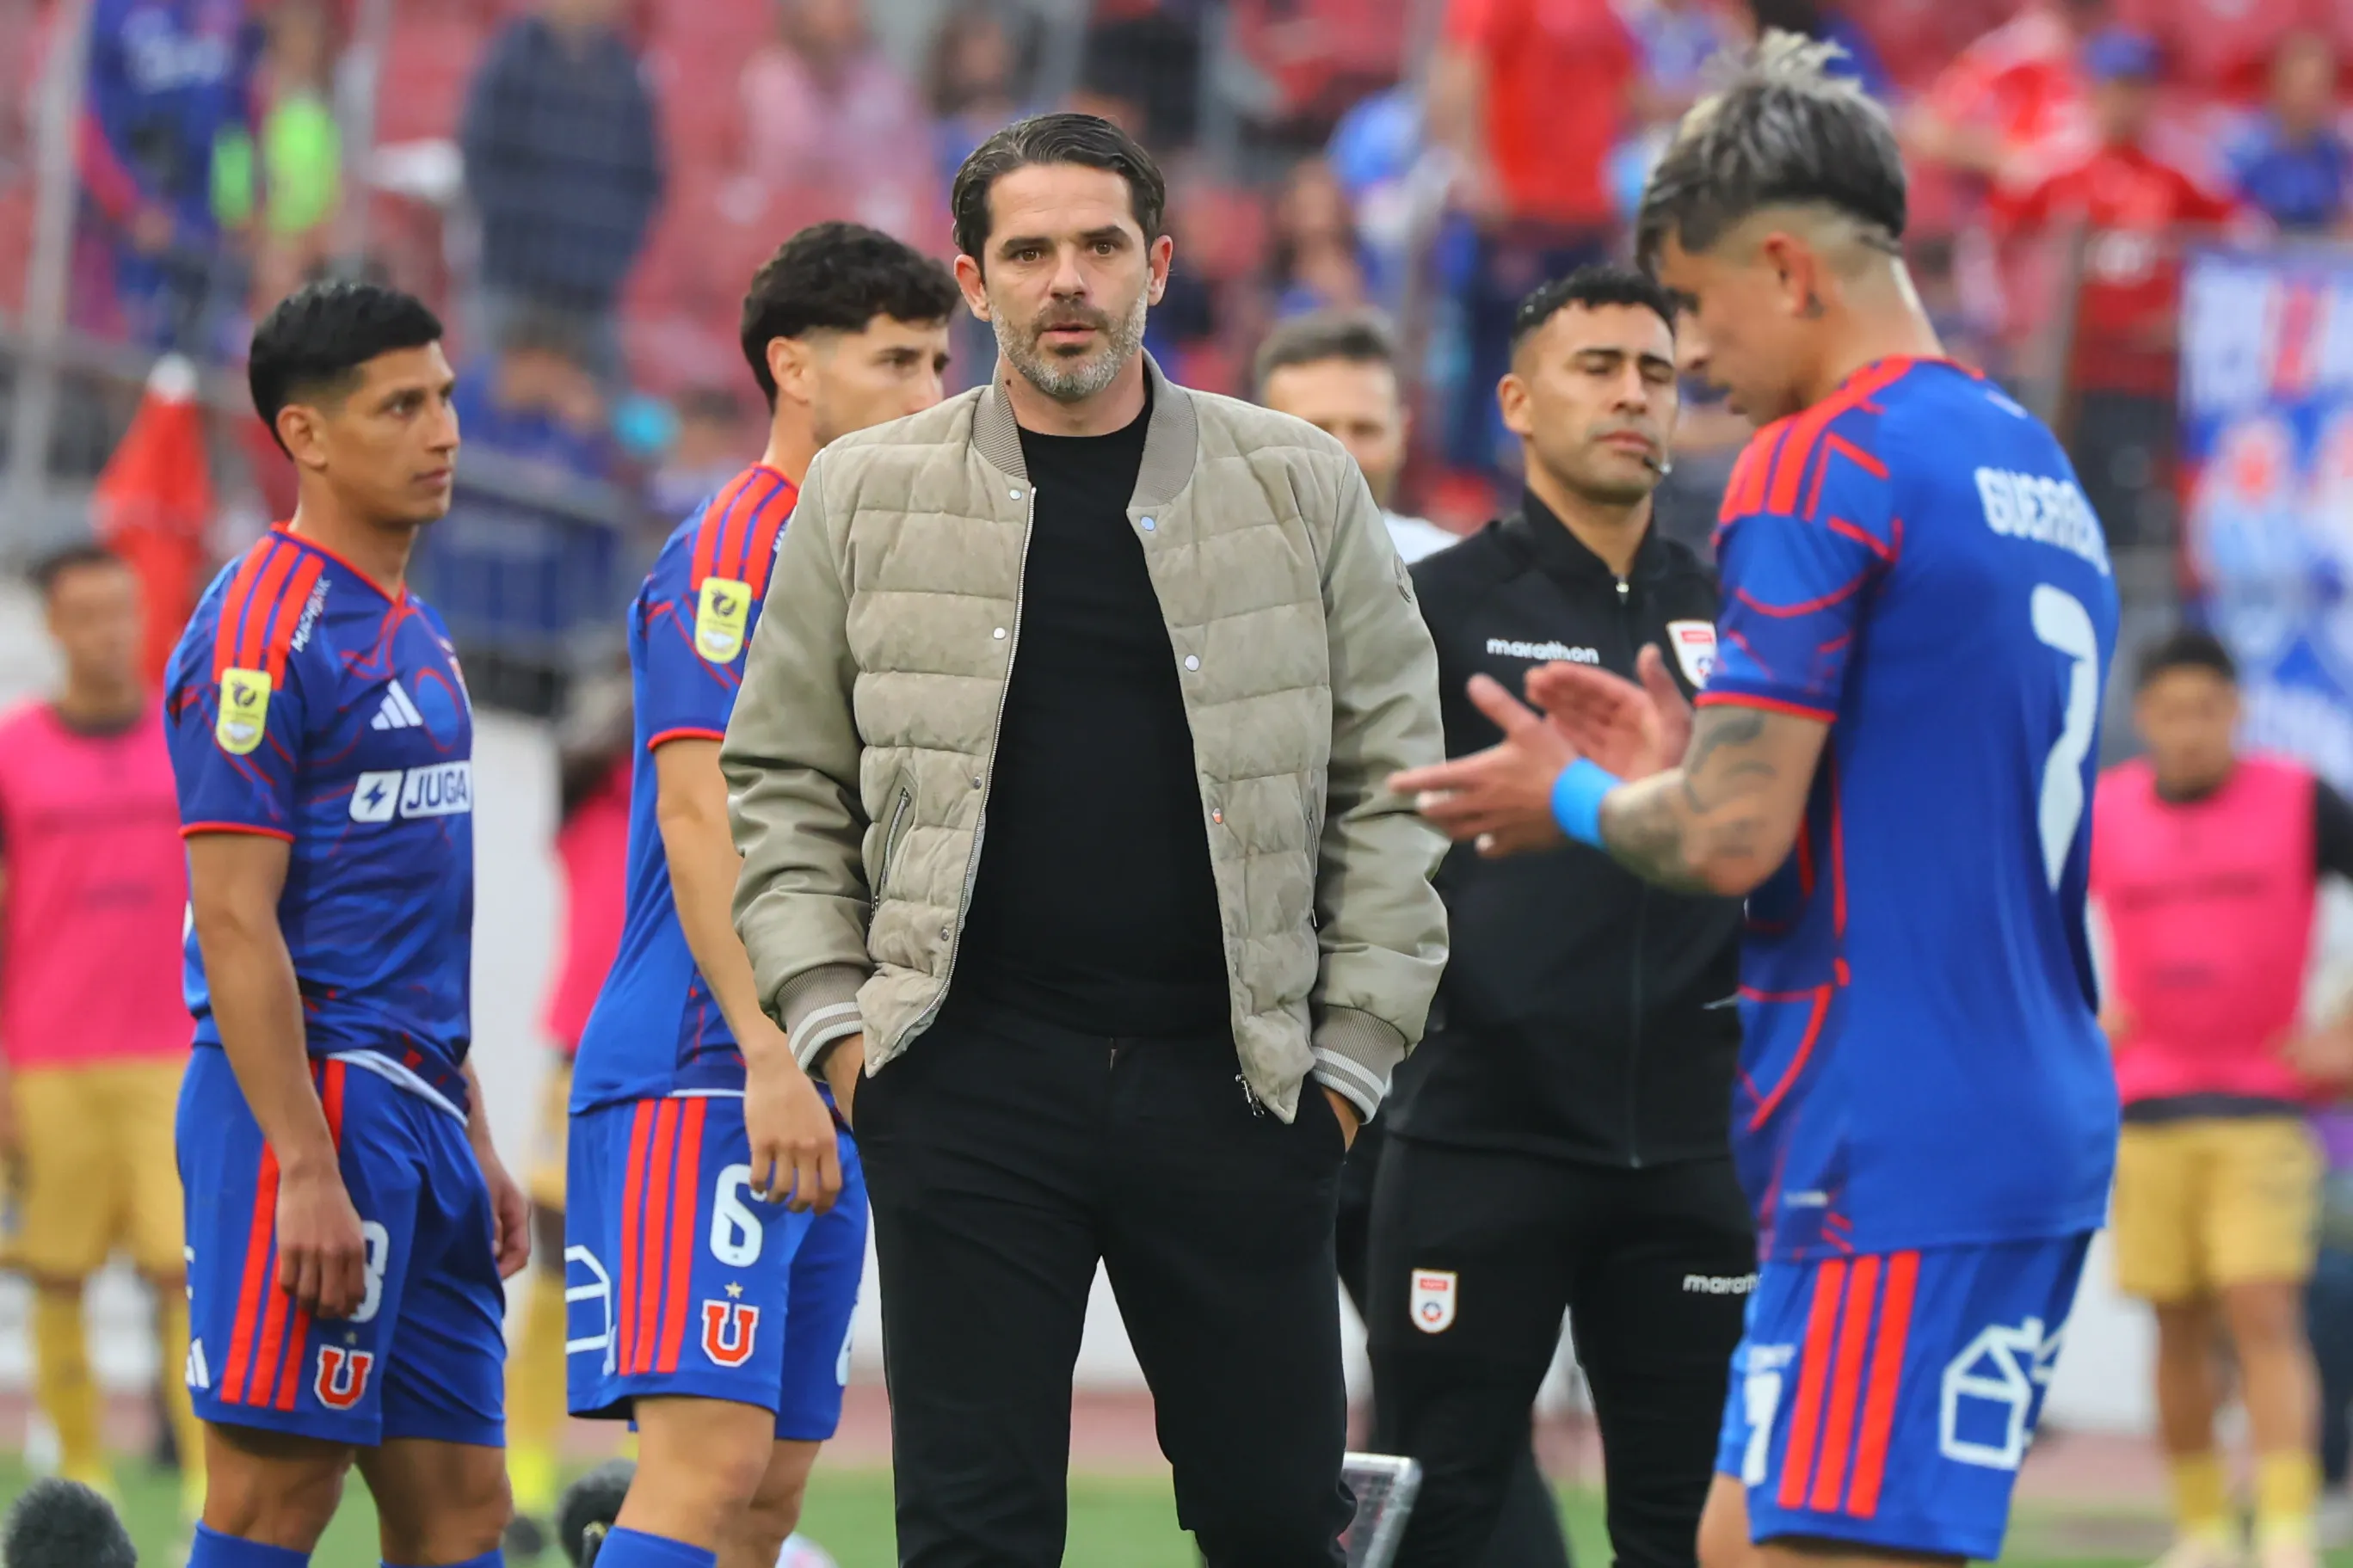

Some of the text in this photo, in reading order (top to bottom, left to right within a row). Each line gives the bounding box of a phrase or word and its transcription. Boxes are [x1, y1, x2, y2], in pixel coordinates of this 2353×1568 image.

[1486, 637, 1600, 665] marathon
[2030, 581, 2098, 893] 7
[404, 768, 468, 811] JUGA
[710, 1163, 767, 1269] 6
[700, 1299, 760, 1368] U
[313, 1343, 374, 1411] U
